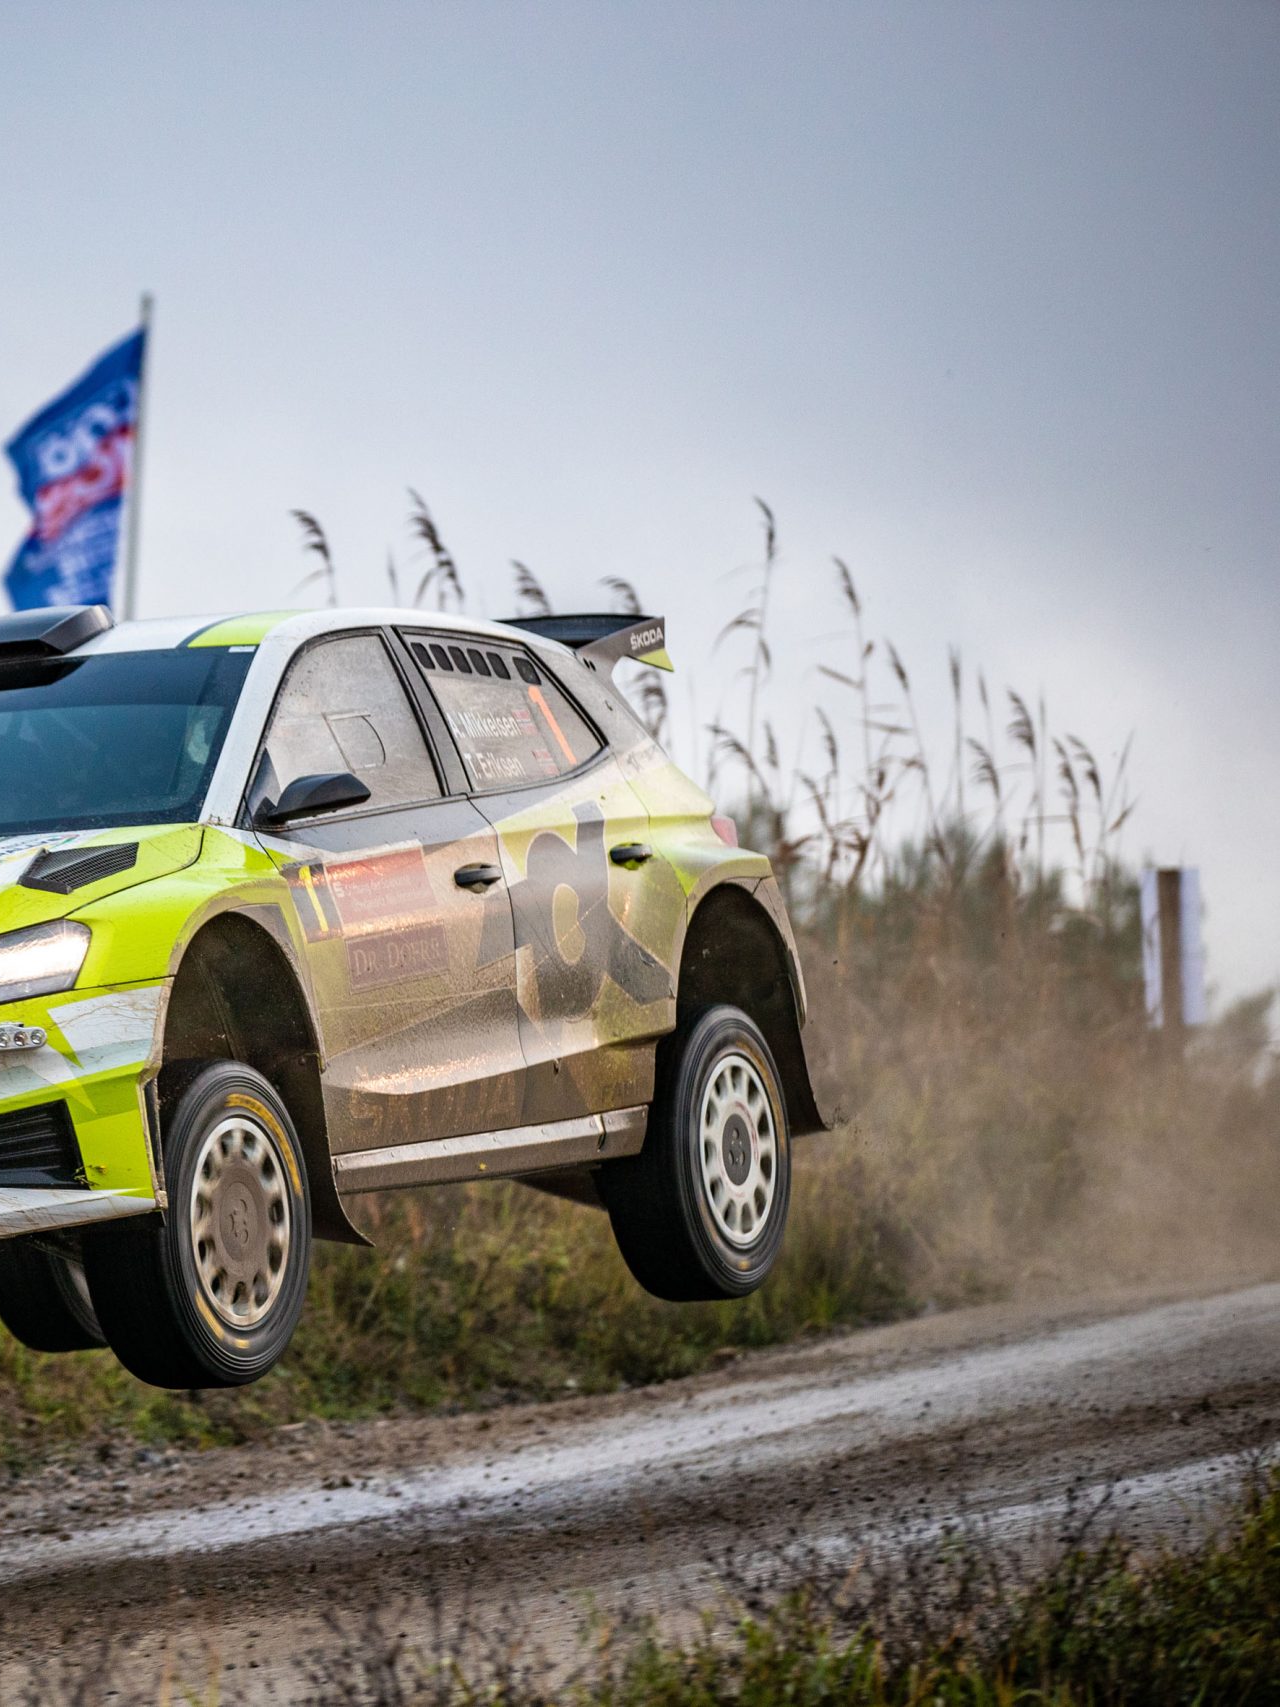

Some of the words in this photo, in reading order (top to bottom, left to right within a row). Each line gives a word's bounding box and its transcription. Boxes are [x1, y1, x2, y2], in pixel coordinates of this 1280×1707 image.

[446, 712, 465, 738] A.
[458, 712, 522, 739] Mikkelsen
[528, 685, 577, 765] 1
[464, 752, 482, 779] T.
[476, 752, 527, 778] Eriksen
[299, 865, 329, 932] 1
